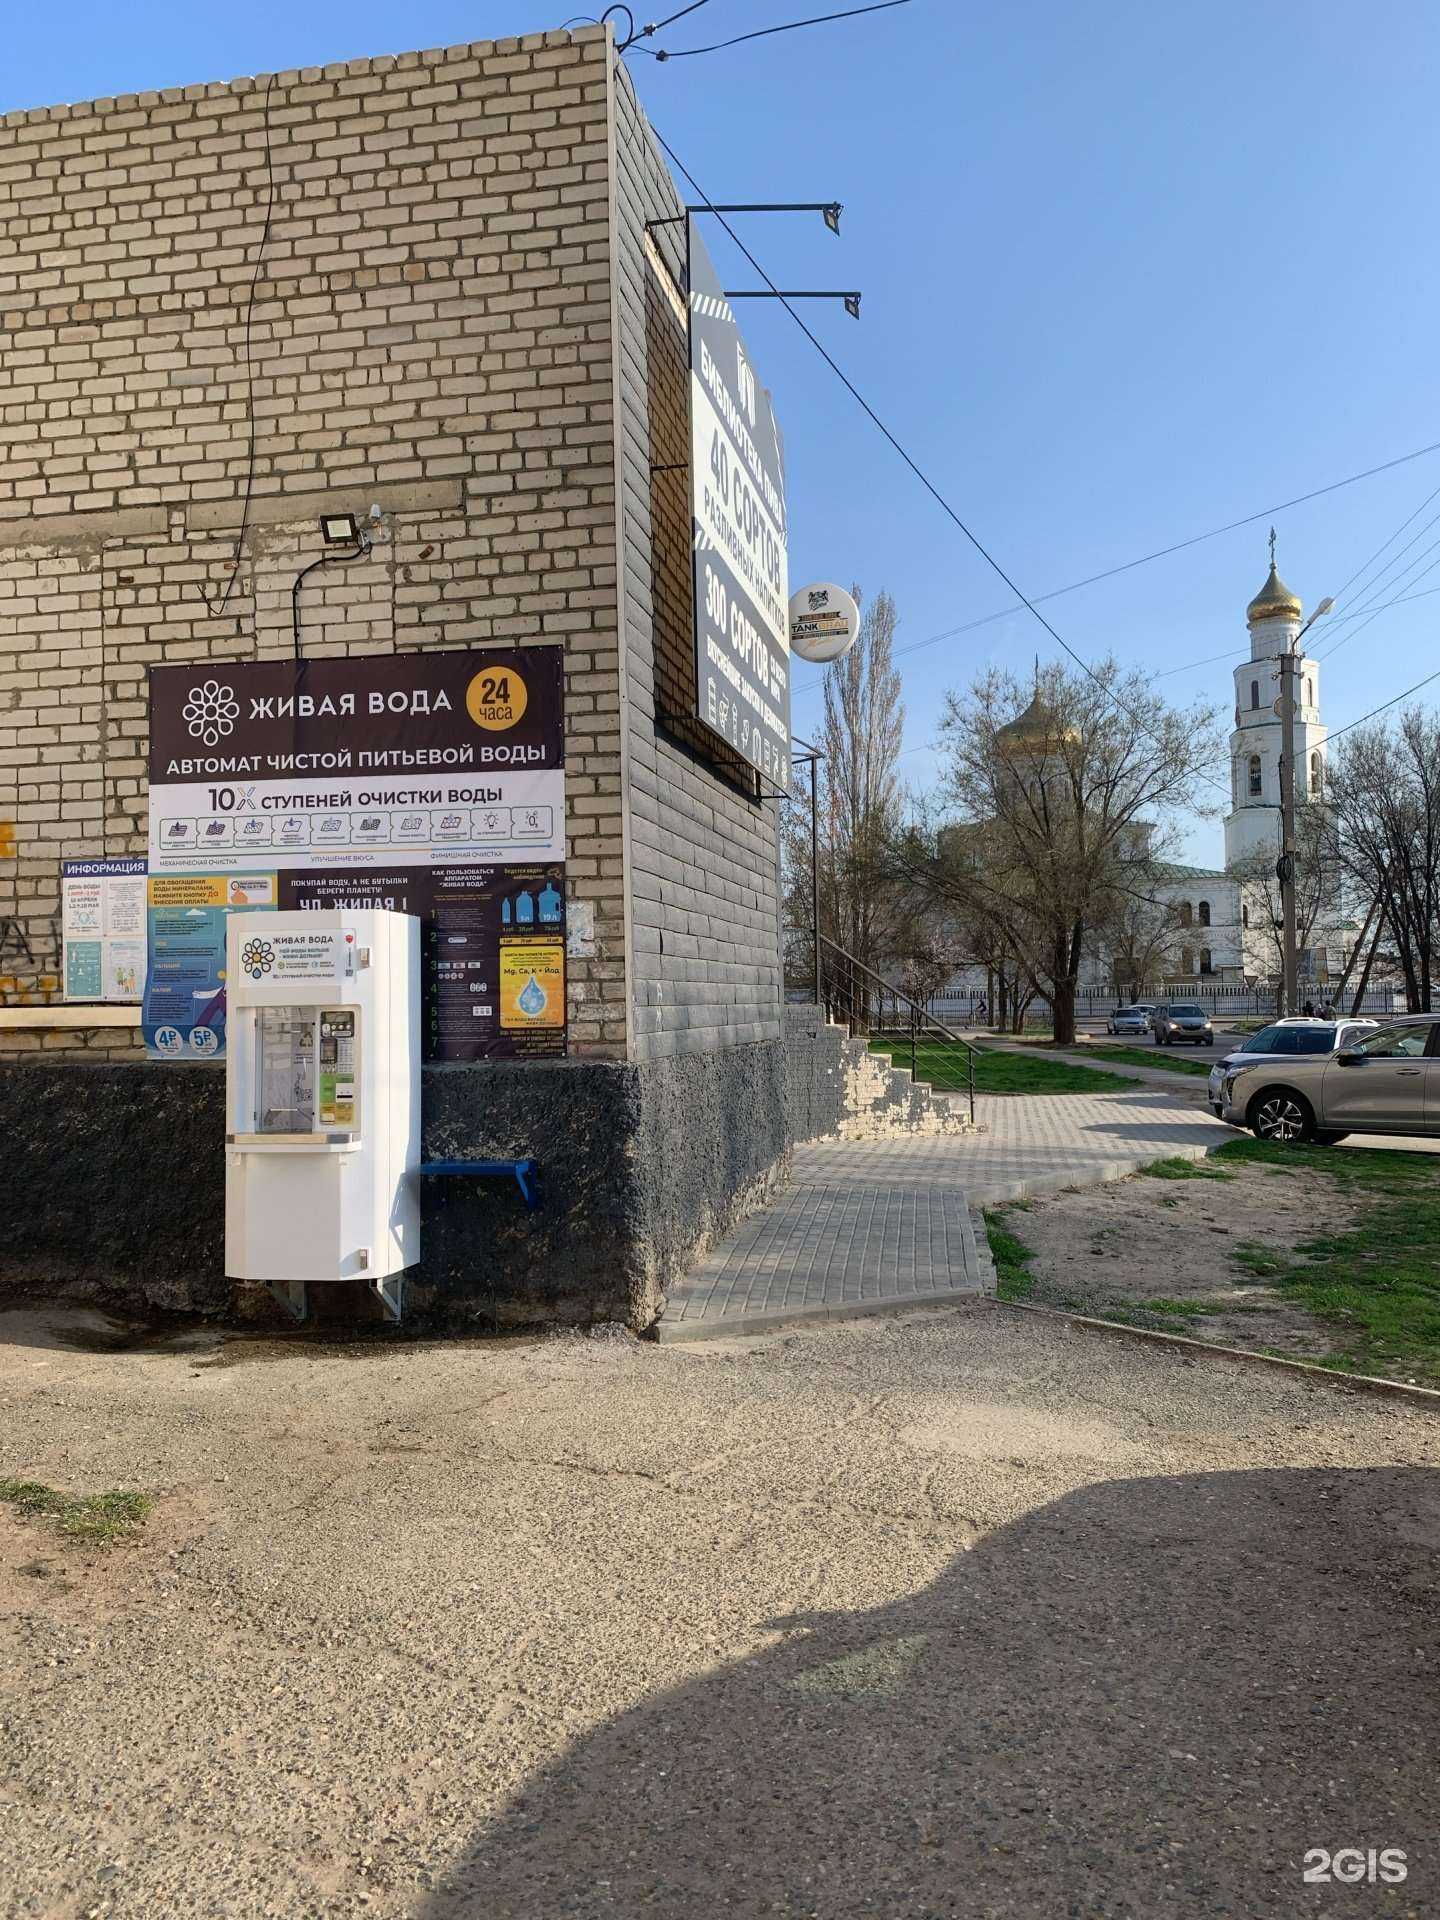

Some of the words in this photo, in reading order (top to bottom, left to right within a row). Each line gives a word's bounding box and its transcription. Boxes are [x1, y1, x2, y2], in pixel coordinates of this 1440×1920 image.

[700, 337, 765, 493] БИБЛИОТЕКА
[710, 427, 729, 507] 40
[733, 466, 781, 595] СОРТОВ
[704, 485, 755, 588] РАЗЛИВНЫХ
[755, 571, 786, 636] НАПИТКОВ
[705, 563, 727, 635] 300
[730, 600, 769, 688] СОРТОВ
[481, 676, 511, 705] 24
[248, 692, 356, 721] ЖИВАЯ
[368, 688, 453, 715] ВОДА
[478, 706, 513, 721] часа
[166, 754, 262, 775] АВТОМАТ
[266, 747, 353, 771] ЧИСТОЙ
[358, 742, 474, 768] ПИТЬЕВОЙ
[481, 744, 547, 763] ВОДЫ
[261, 790, 353, 810] СТУПЕНЕЙ
[358, 790, 443, 807] ОЧИСТКИ
[448, 787, 503, 804] ВОДЫ
[67, 862, 145, 875] ИНФОРМАЦИЯ
[291, 879, 326, 887] ПОКУПАЙ
[372, 877, 408, 885] БУТЫЛКИ
[317, 887, 345, 895] БЕРЕГИ
[272, 936, 306, 945] ЖИВАЯ
[308, 936, 334, 944] ВОДА
[430, 931, 437, 942] 2
[430, 983, 437, 993] 4
